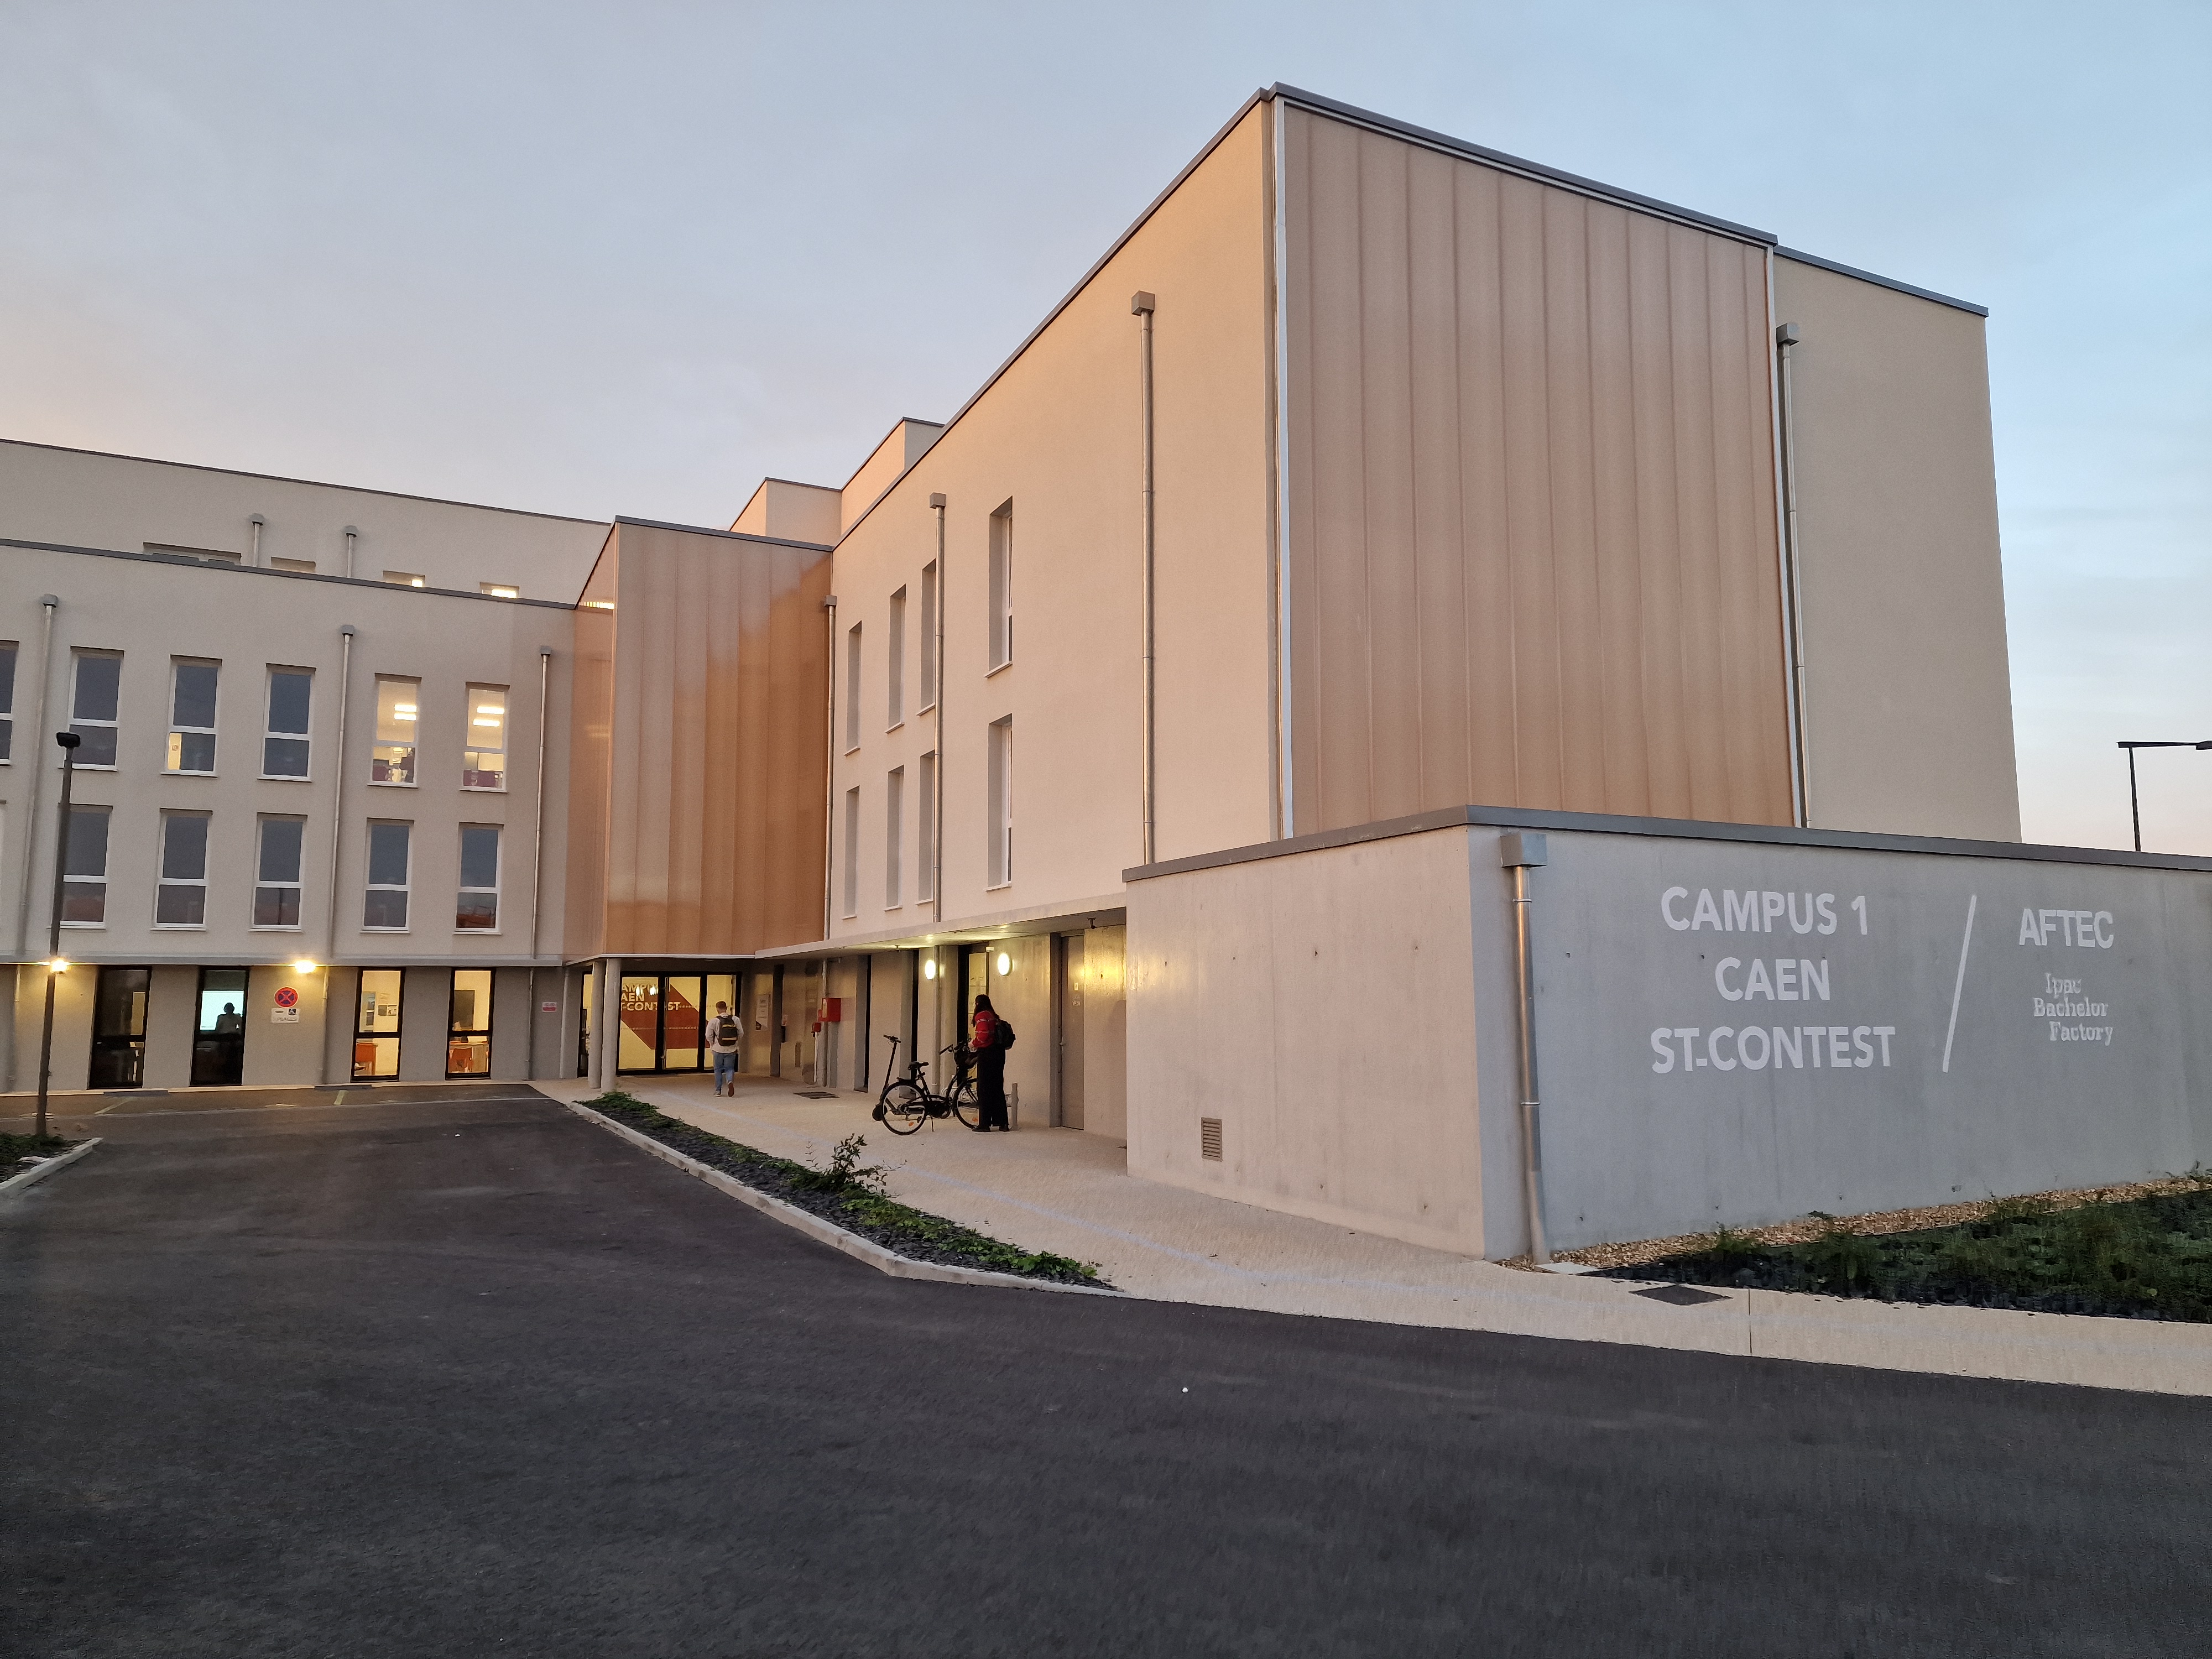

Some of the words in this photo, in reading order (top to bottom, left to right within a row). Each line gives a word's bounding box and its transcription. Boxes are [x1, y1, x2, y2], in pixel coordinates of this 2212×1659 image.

[1661, 886, 1838, 935] CAMPUS
[1851, 895, 1867, 935] 1
[2019, 909, 2114, 949] AFTEC
[621, 993, 645, 1001] AEN
[1715, 957, 1830, 1001] CAEN
[2033, 996, 2109, 1017] Bachelor
[1651, 1026, 1896, 1074] ST-CONTEST
[2049, 1021, 2114, 1046] Factory
